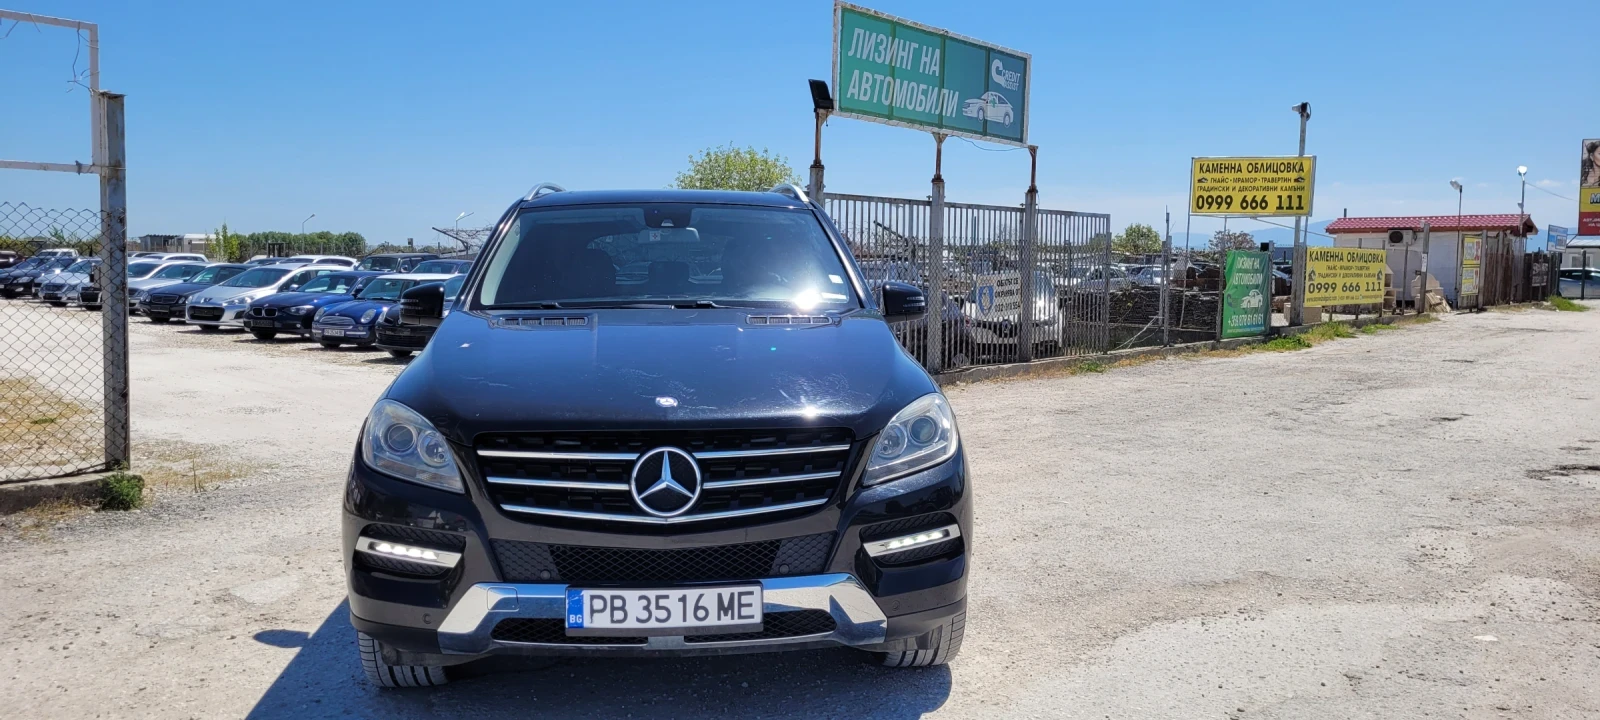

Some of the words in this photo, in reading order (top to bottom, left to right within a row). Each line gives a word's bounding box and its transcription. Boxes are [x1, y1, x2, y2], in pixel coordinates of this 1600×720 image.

[848, 28, 919, 71] ЛИЗИНГ
[919, 45, 940, 77] НА
[1001, 69, 1021, 83] CREDIT
[846, 69, 960, 118] АВТОМОБИЛИ
[1199, 162, 1243, 174] КАМЕННА
[1246, 162, 1305, 175] ОБЛИЦОВКА
[1210, 176, 1229, 184] ГНАЙС
[1196, 194, 1234, 210] 0999
[1240, 194, 1269, 210] 666
[1276, 194, 1304, 210] 111
[1309, 250, 1344, 263] КАМЕННА
[1346, 251, 1384, 264] ОБЛИЦОВКА
[1308, 282, 1337, 294] 0999
[1341, 281, 1361, 292] 666
[1365, 281, 1382, 292] 111
[589, 594, 628, 624] PB
[635, 593, 710, 624] 3516
[717, 591, 755, 621] ME
[569, 614, 583, 623] BG
